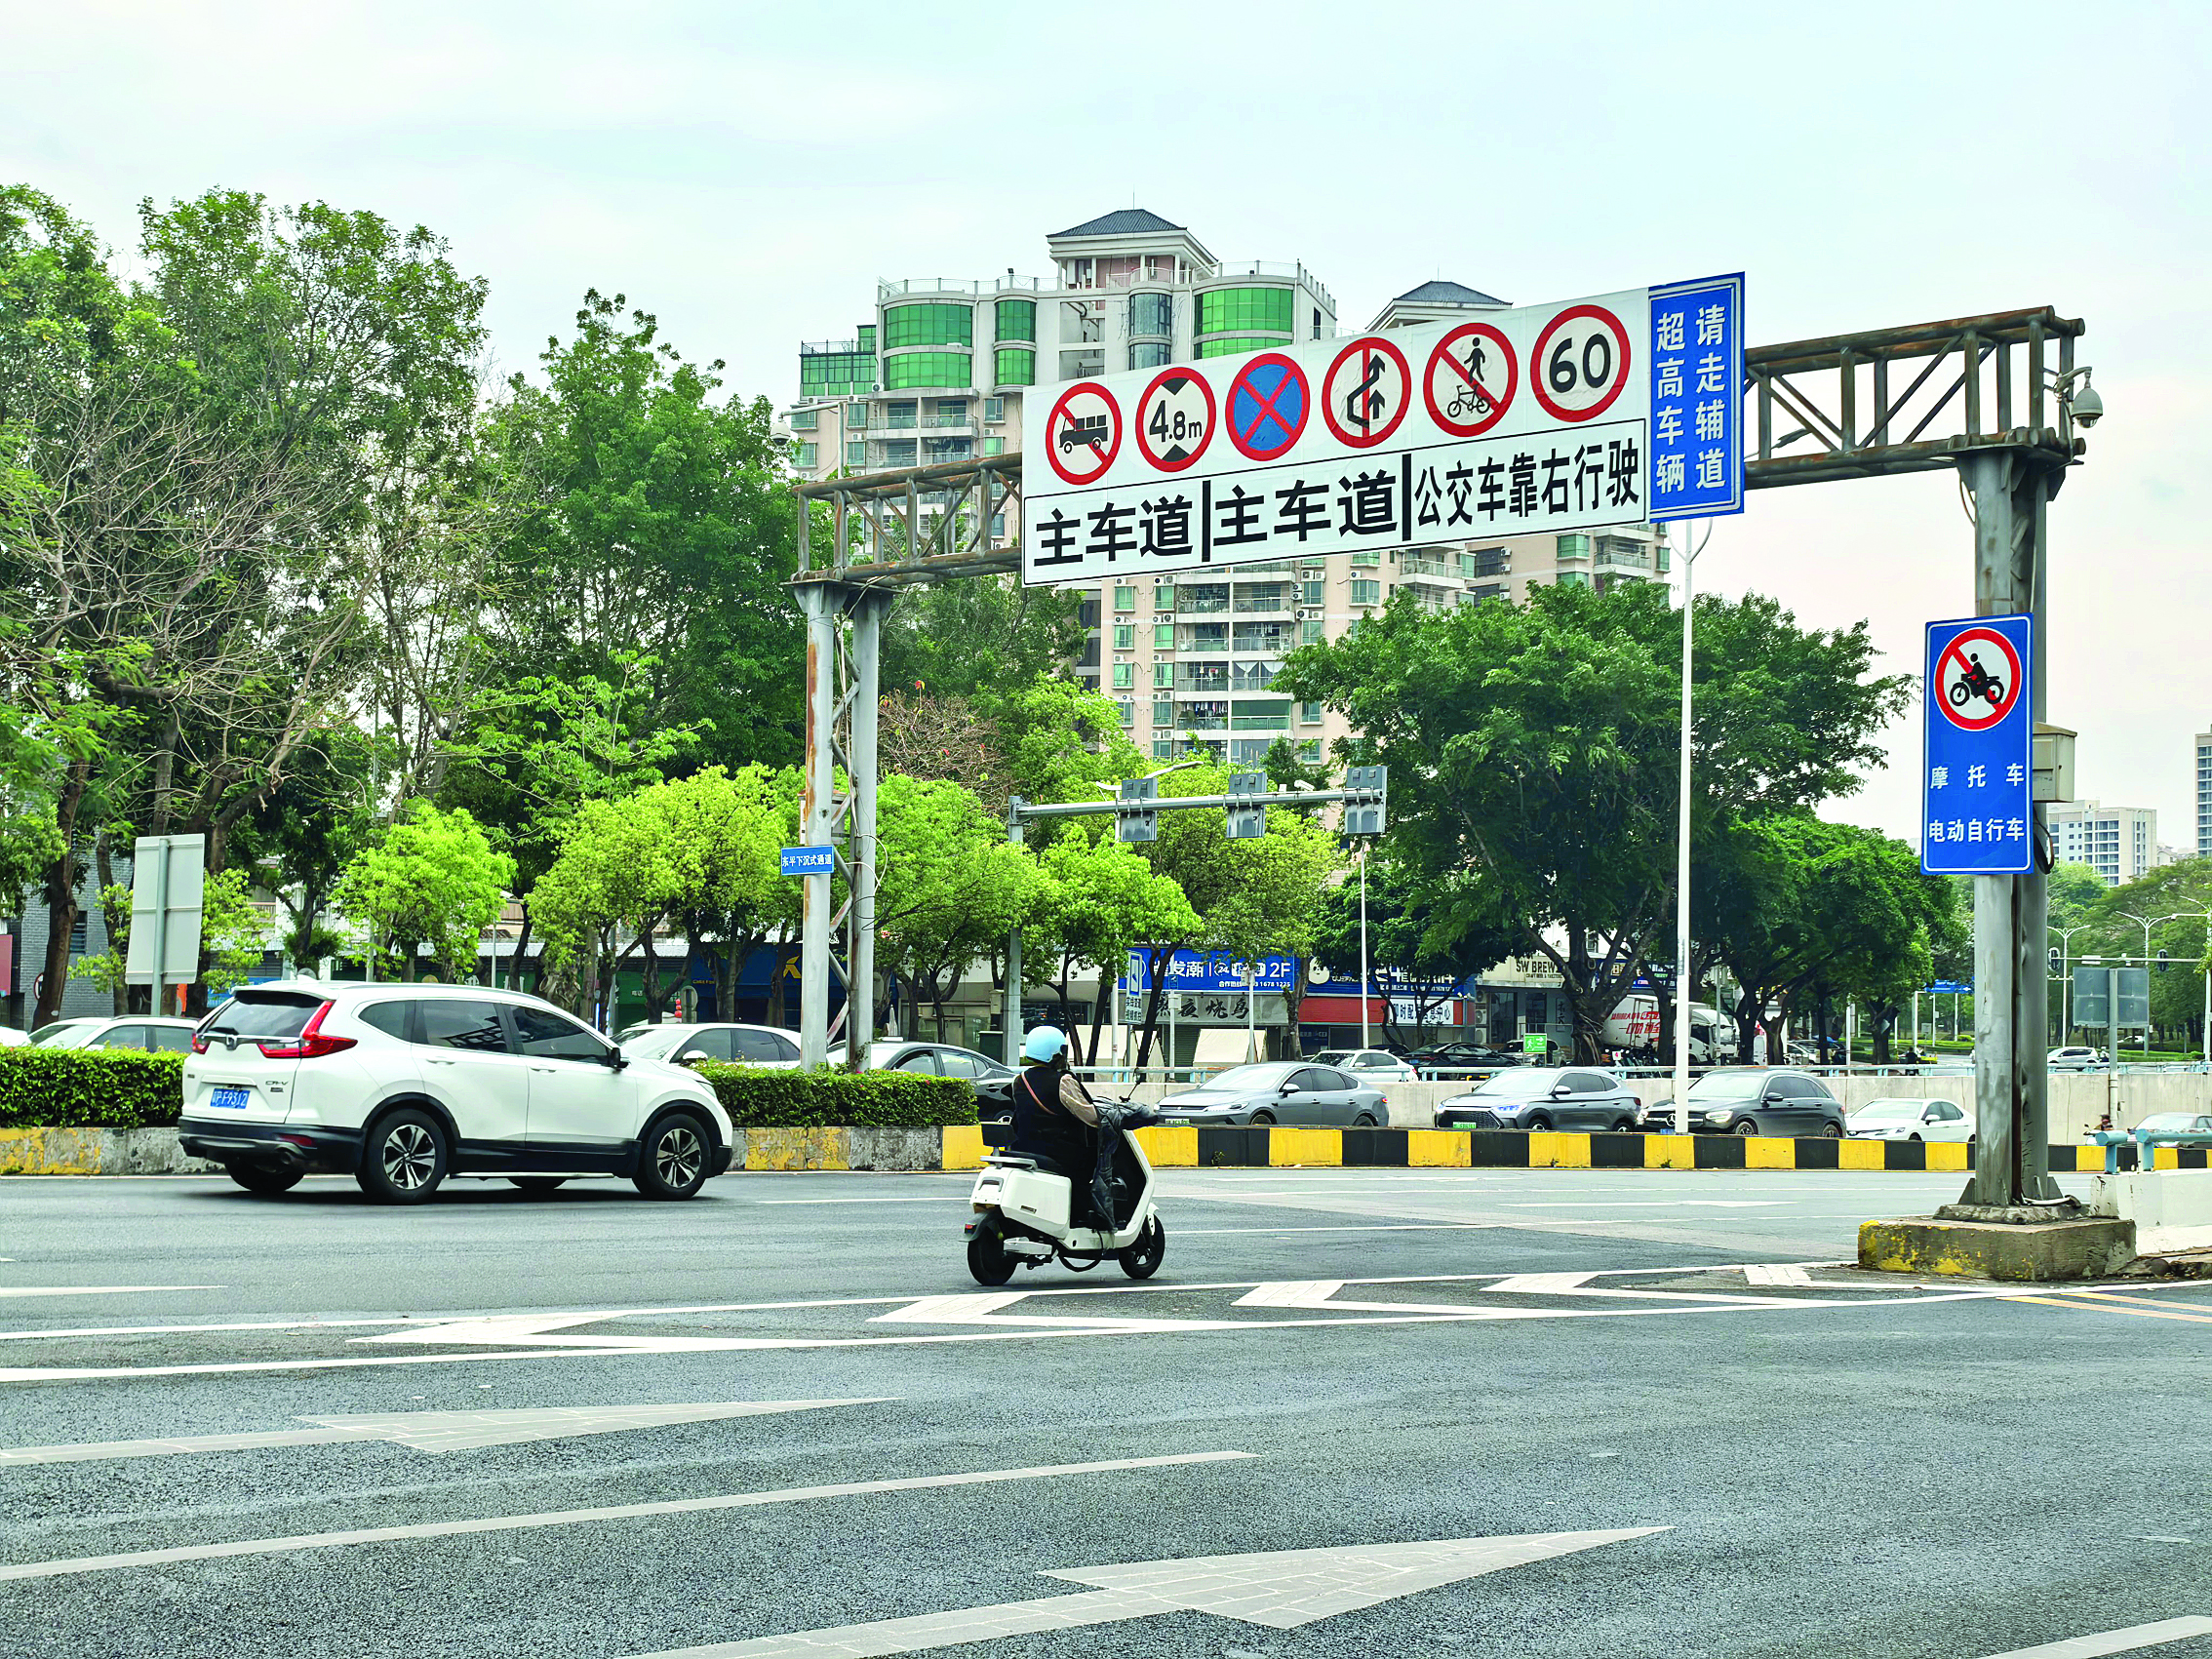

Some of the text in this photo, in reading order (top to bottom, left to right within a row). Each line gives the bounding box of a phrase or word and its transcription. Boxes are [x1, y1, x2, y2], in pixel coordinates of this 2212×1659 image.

[1549, 333, 1611, 393] 60
[1150, 407, 1204, 443] 4.8m
[1656, 311, 1685, 494] 超高车辆
[1695, 302, 1726, 491] 请走辅道
[1213, 467, 1398, 546] 主车道
[1414, 438, 1640, 528] 公交车靠右行驶
[1034, 494, 1195, 567] 主车道
[1930, 763, 2025, 790] 摩托车
[1928, 816, 2025, 843] 电动自行车
[1269, 962, 1291, 978] 2F
[1531, 961, 1561, 973] BREW
